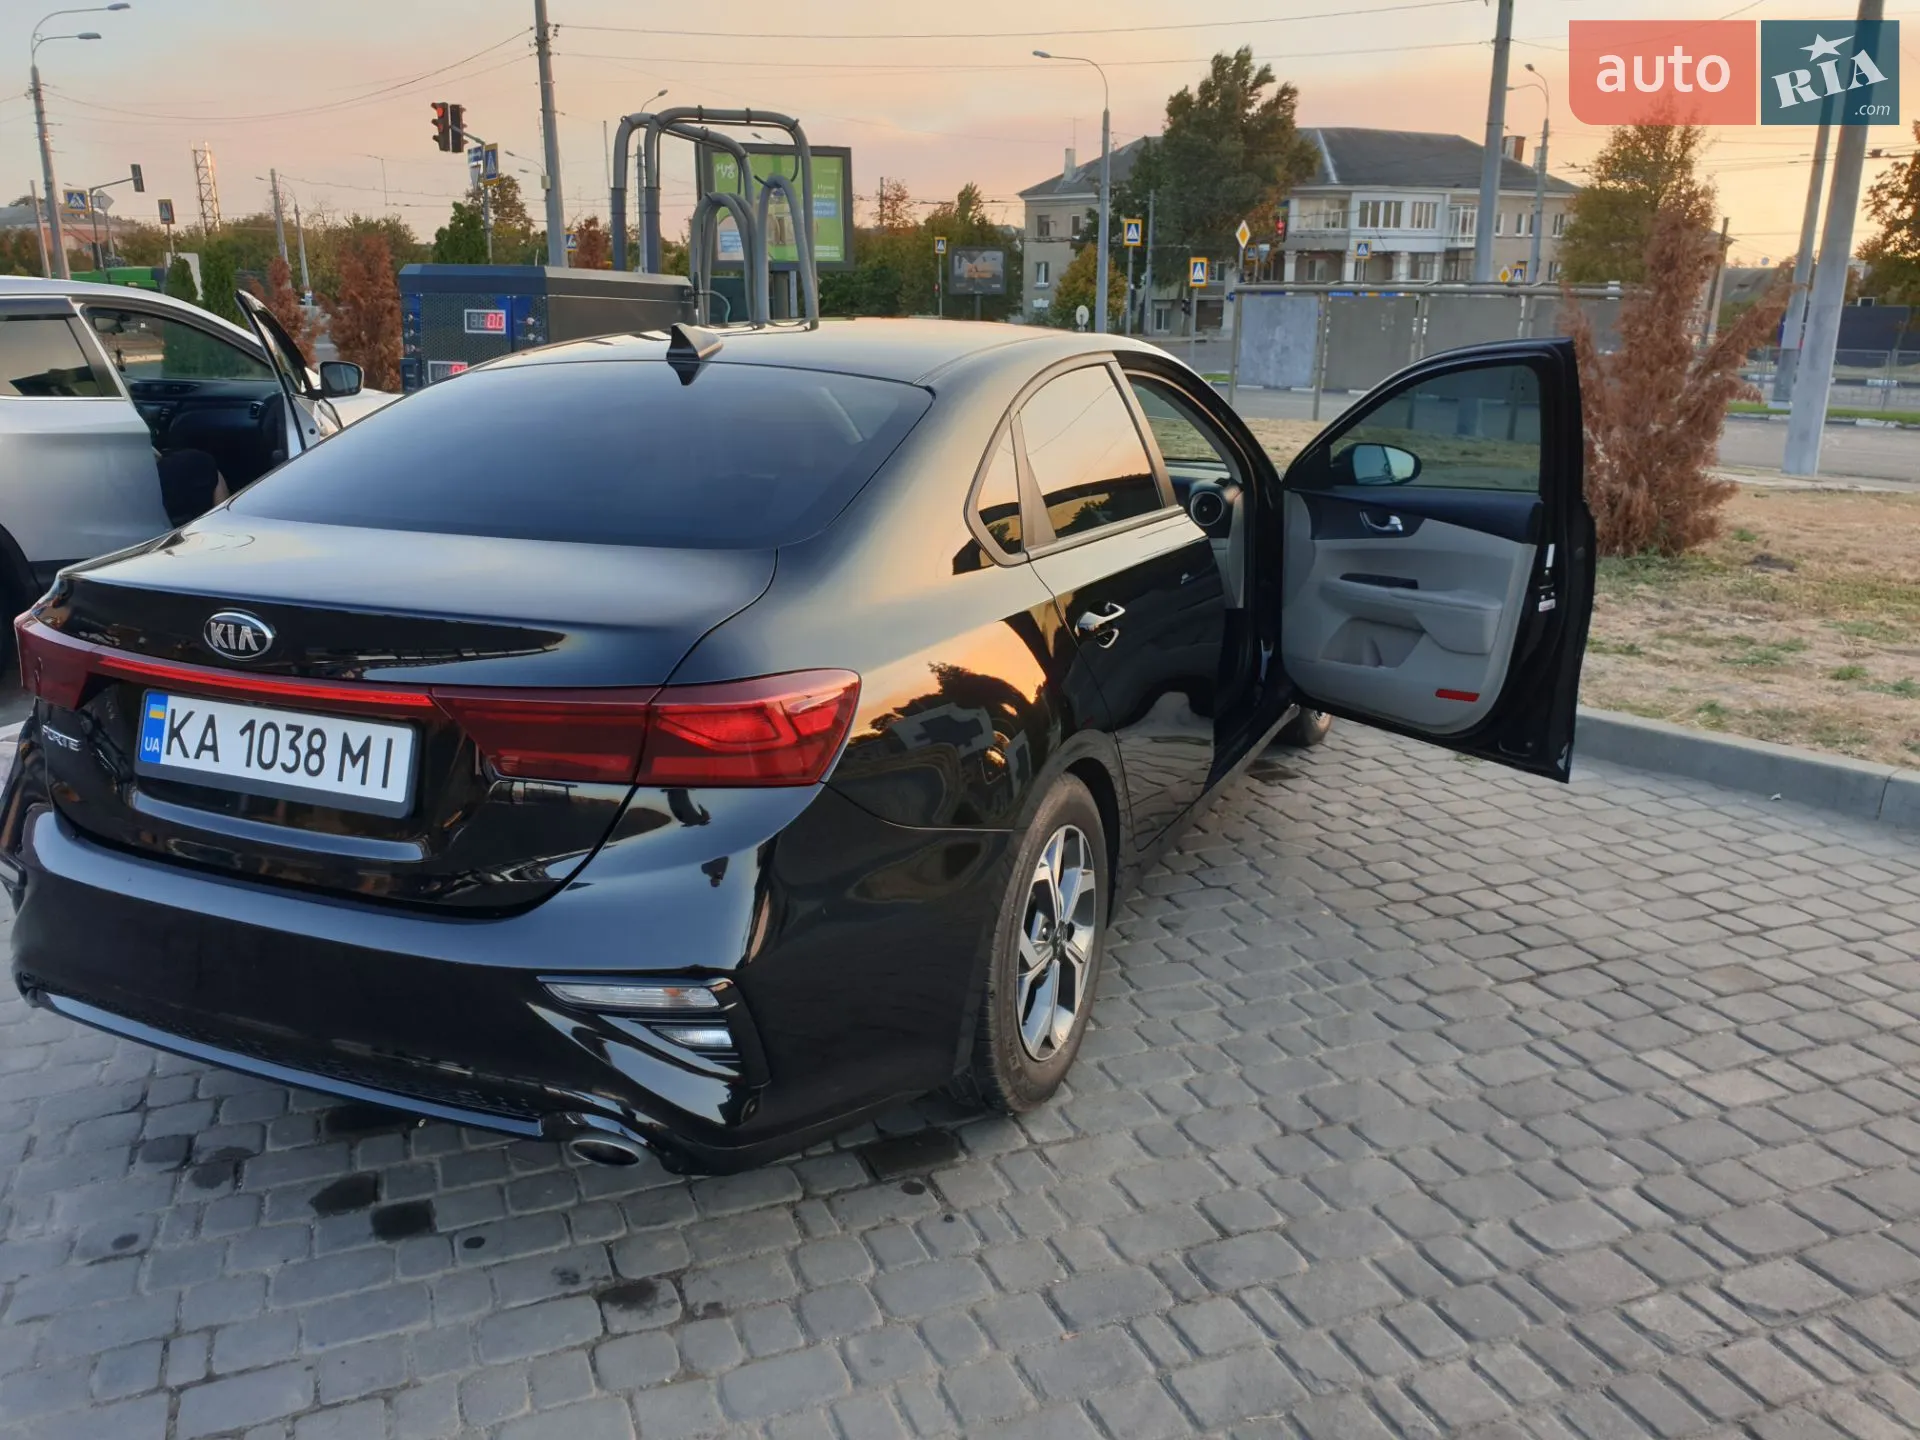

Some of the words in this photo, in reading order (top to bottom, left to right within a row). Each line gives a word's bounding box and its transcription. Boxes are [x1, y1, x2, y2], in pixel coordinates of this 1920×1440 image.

[210, 621, 259, 651] KIA
[144, 736, 161, 754] UA
[165, 708, 220, 763] KA
[239, 718, 327, 777] 1038
[337, 731, 394, 789] MI
